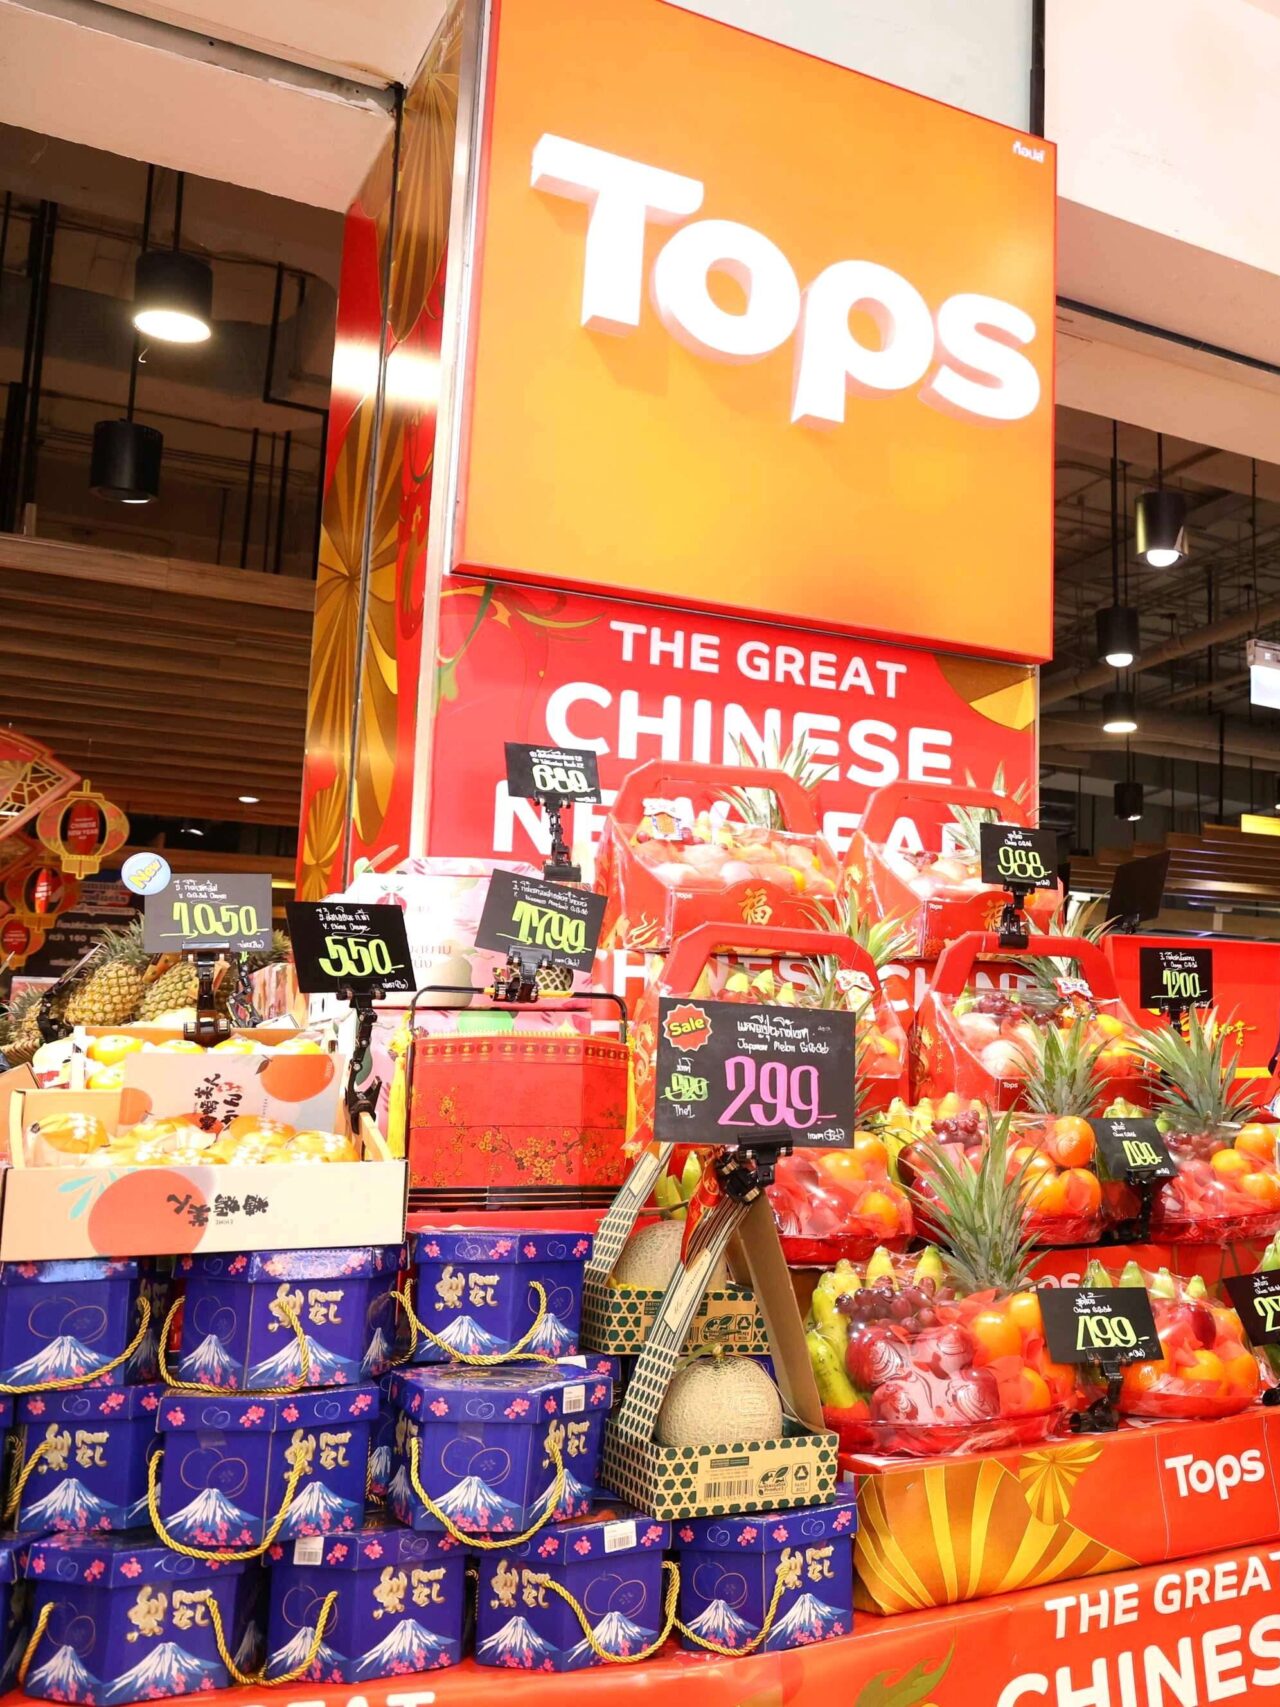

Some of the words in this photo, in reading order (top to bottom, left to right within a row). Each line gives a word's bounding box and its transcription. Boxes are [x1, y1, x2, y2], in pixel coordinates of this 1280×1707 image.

[530, 133, 1041, 425] Tops
[610, 620, 721, 674] THE
[737, 641, 907, 699] GREAT
[545, 682, 953, 787] CHINESE
[129, 859, 163, 889] New
[738, 888, 773, 926] 福
[669, 1017, 706, 1037] Sale
[1002, 1082, 1019, 1090] Tops
[1165, 1448, 1265, 1501] Tops
[1045, 1582, 1139, 1639] THE
